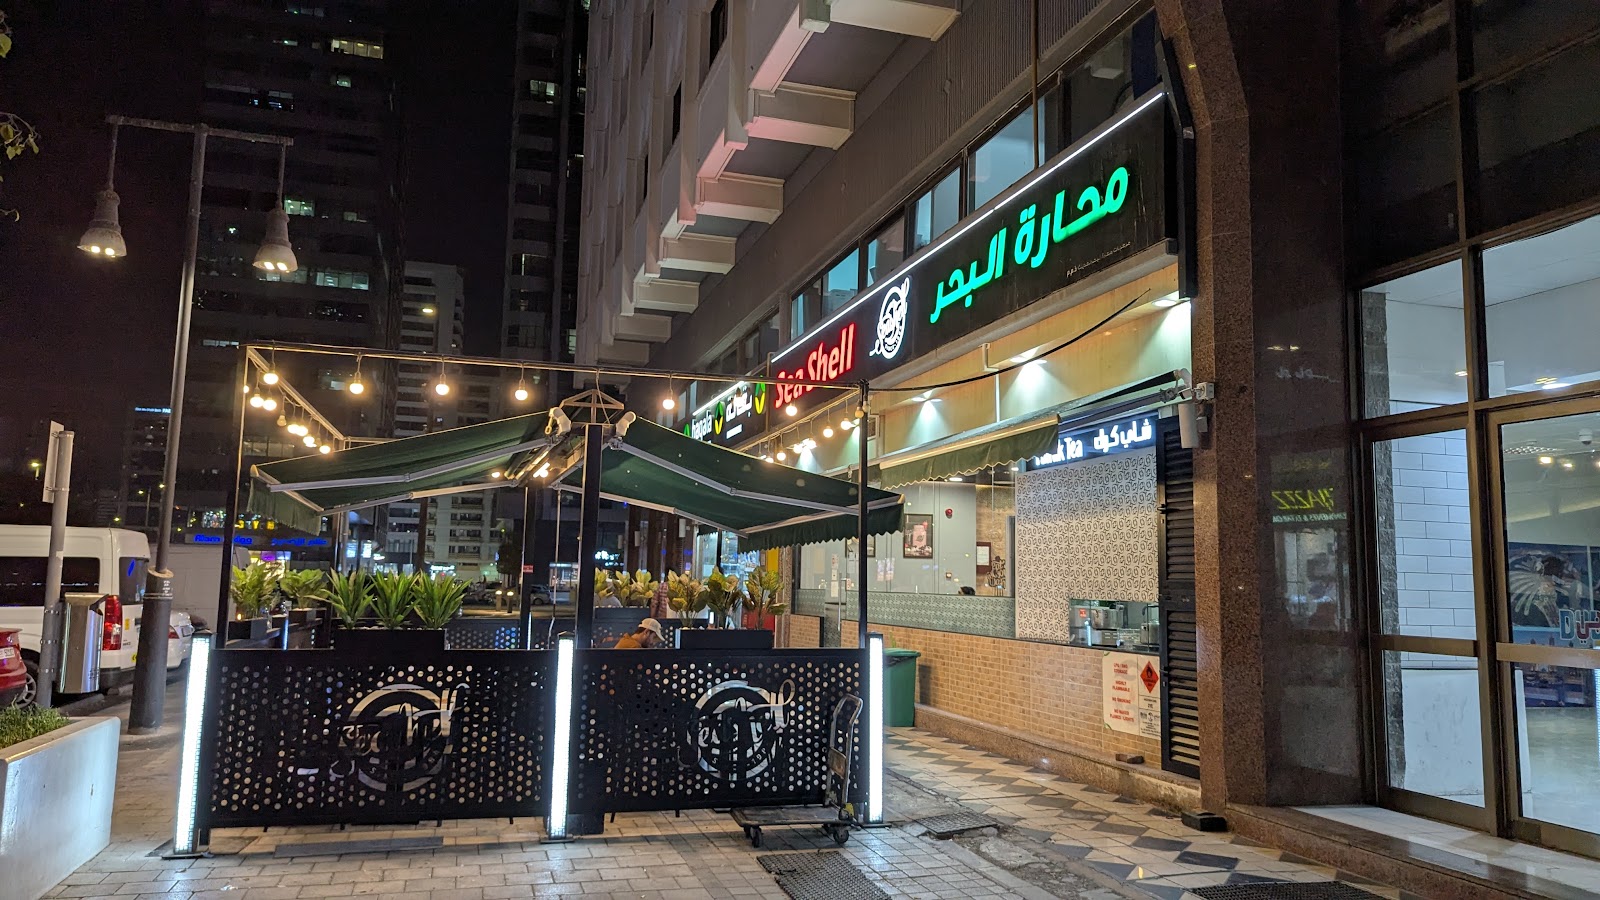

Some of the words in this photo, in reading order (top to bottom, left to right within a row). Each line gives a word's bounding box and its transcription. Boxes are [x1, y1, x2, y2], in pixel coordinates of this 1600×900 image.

[1014, 167, 1129, 269] محارة
[930, 227, 1007, 324] البحر
[775, 368, 804, 409] Sea
[806, 323, 855, 392] Shell
[1064, 436, 1084, 460] Tea
